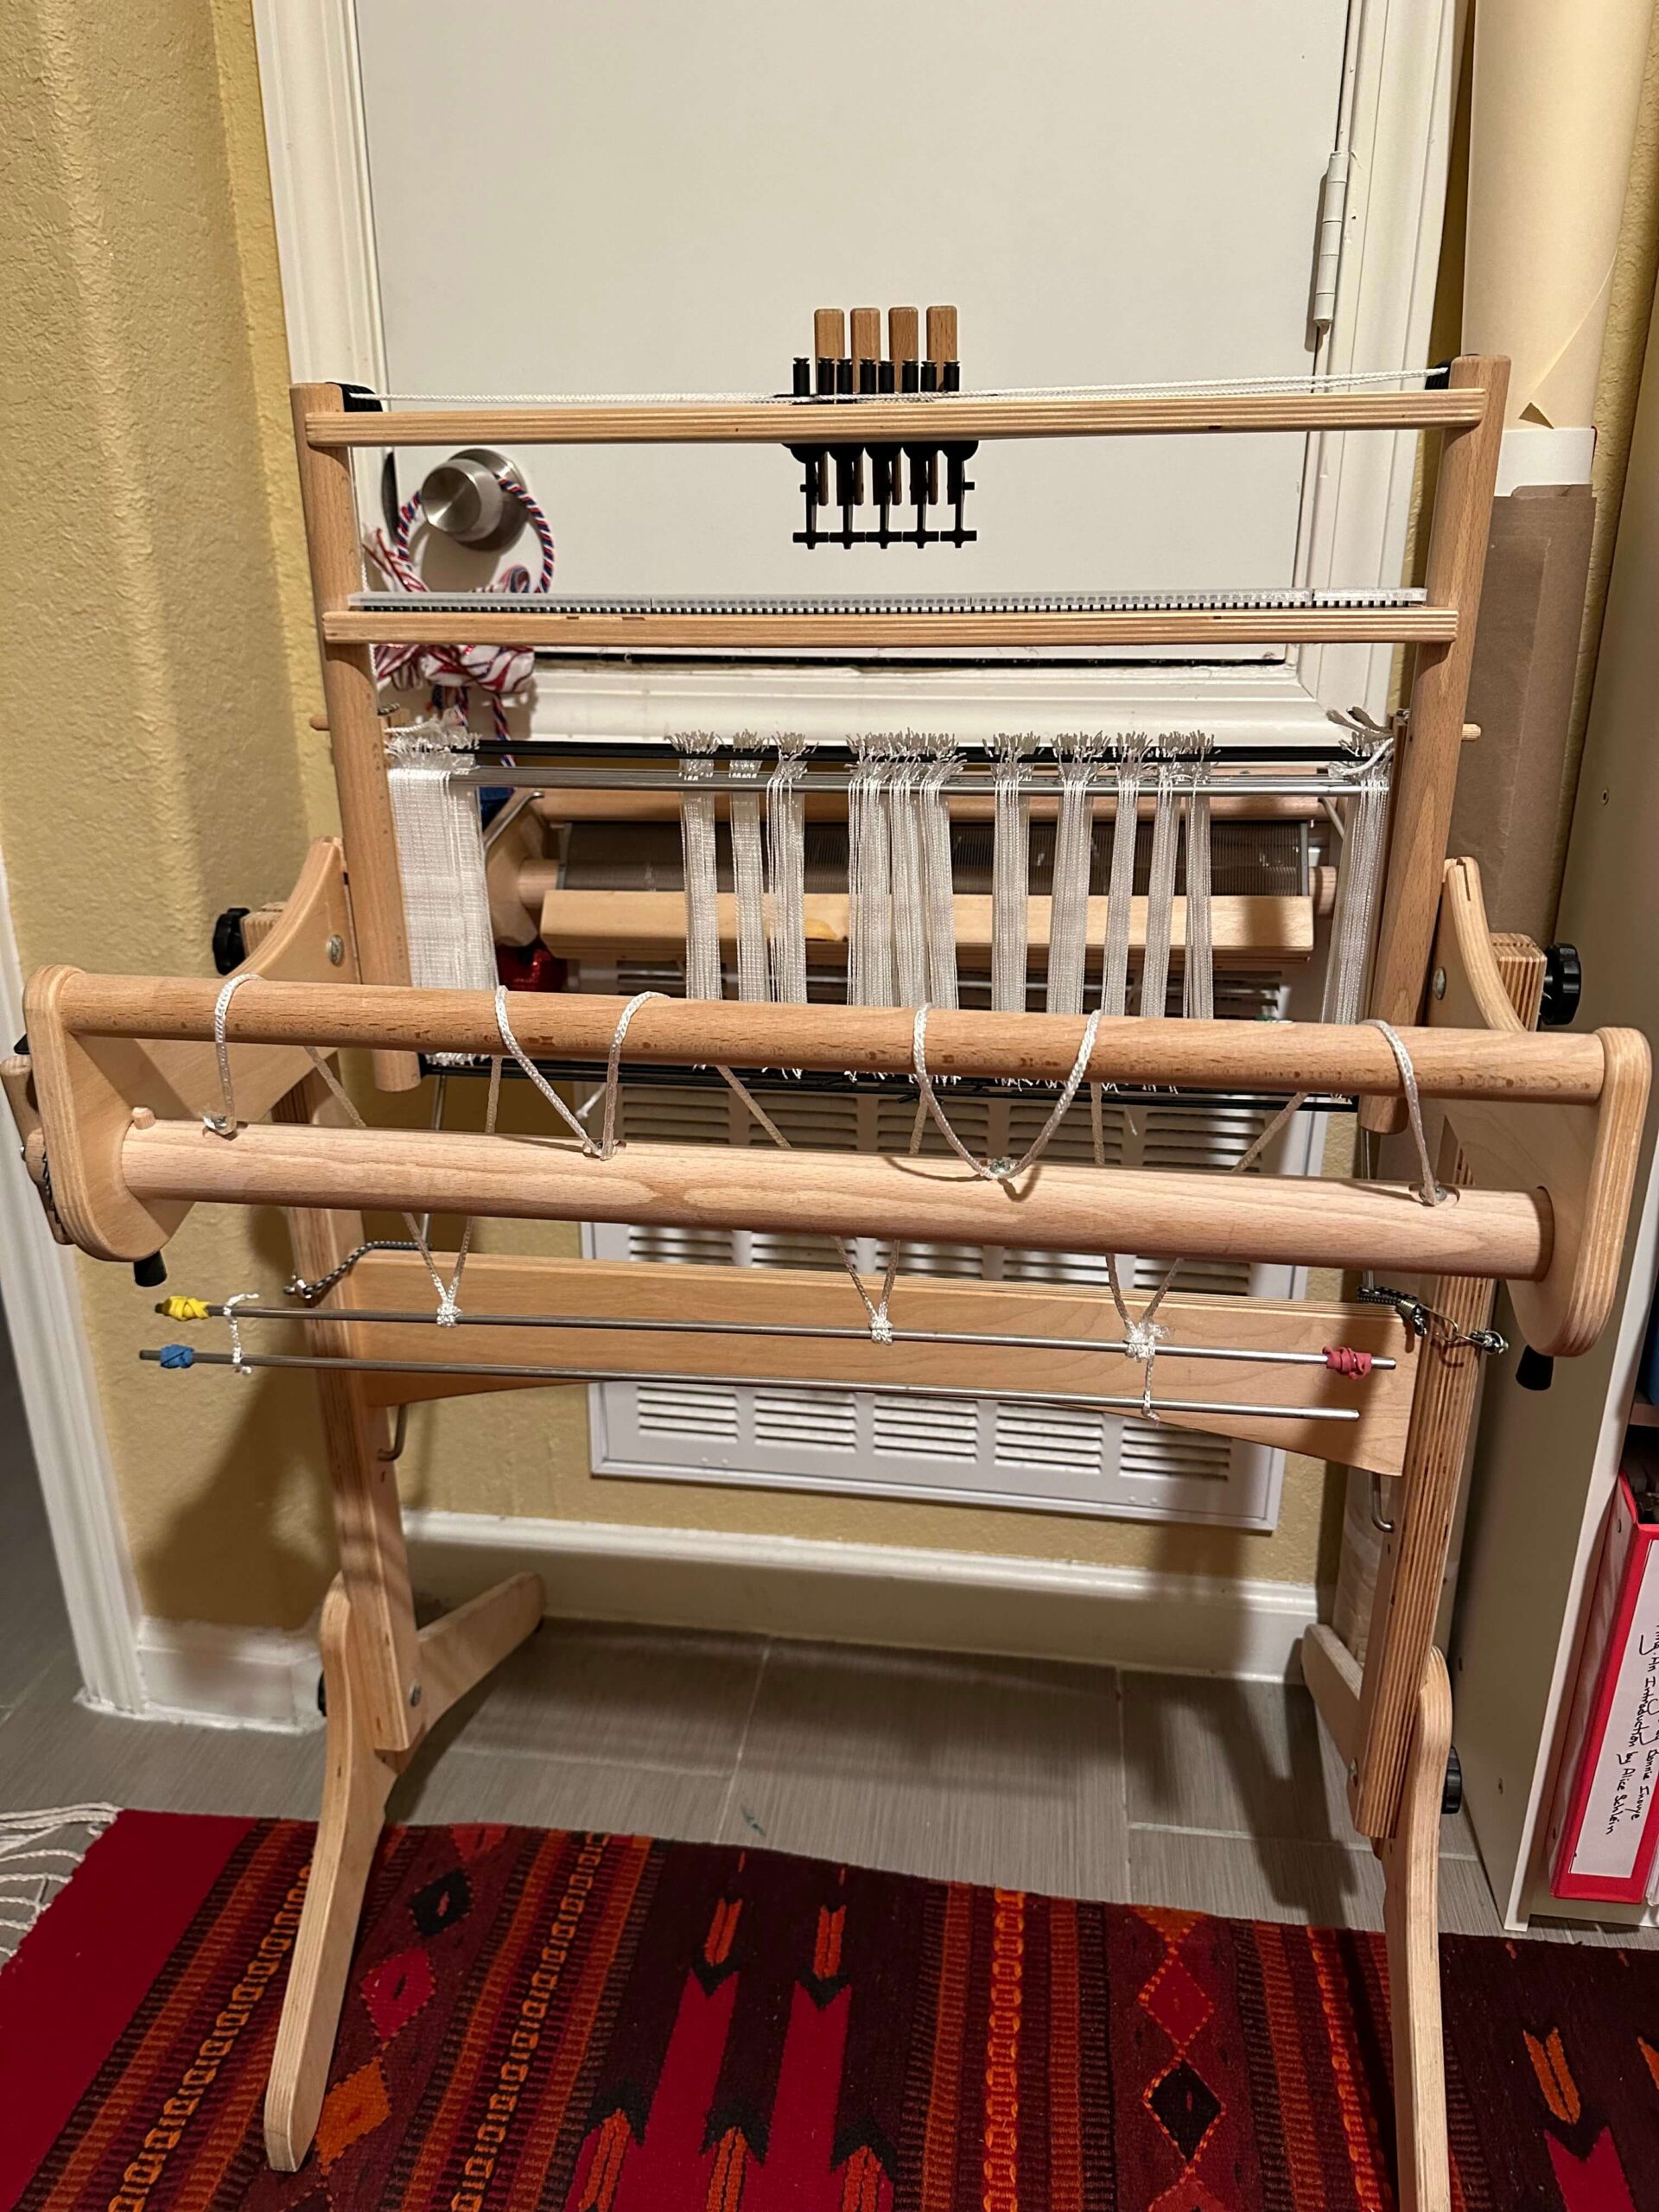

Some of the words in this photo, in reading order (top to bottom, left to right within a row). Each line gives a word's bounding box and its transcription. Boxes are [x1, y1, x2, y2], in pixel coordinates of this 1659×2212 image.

[1629, 1676, 1656, 1747] Introduction
[1616, 1751, 1638, 1764] by
[1617, 1768, 1636, 1791] Alice
[1605, 1794, 1628, 1834] Schlein
